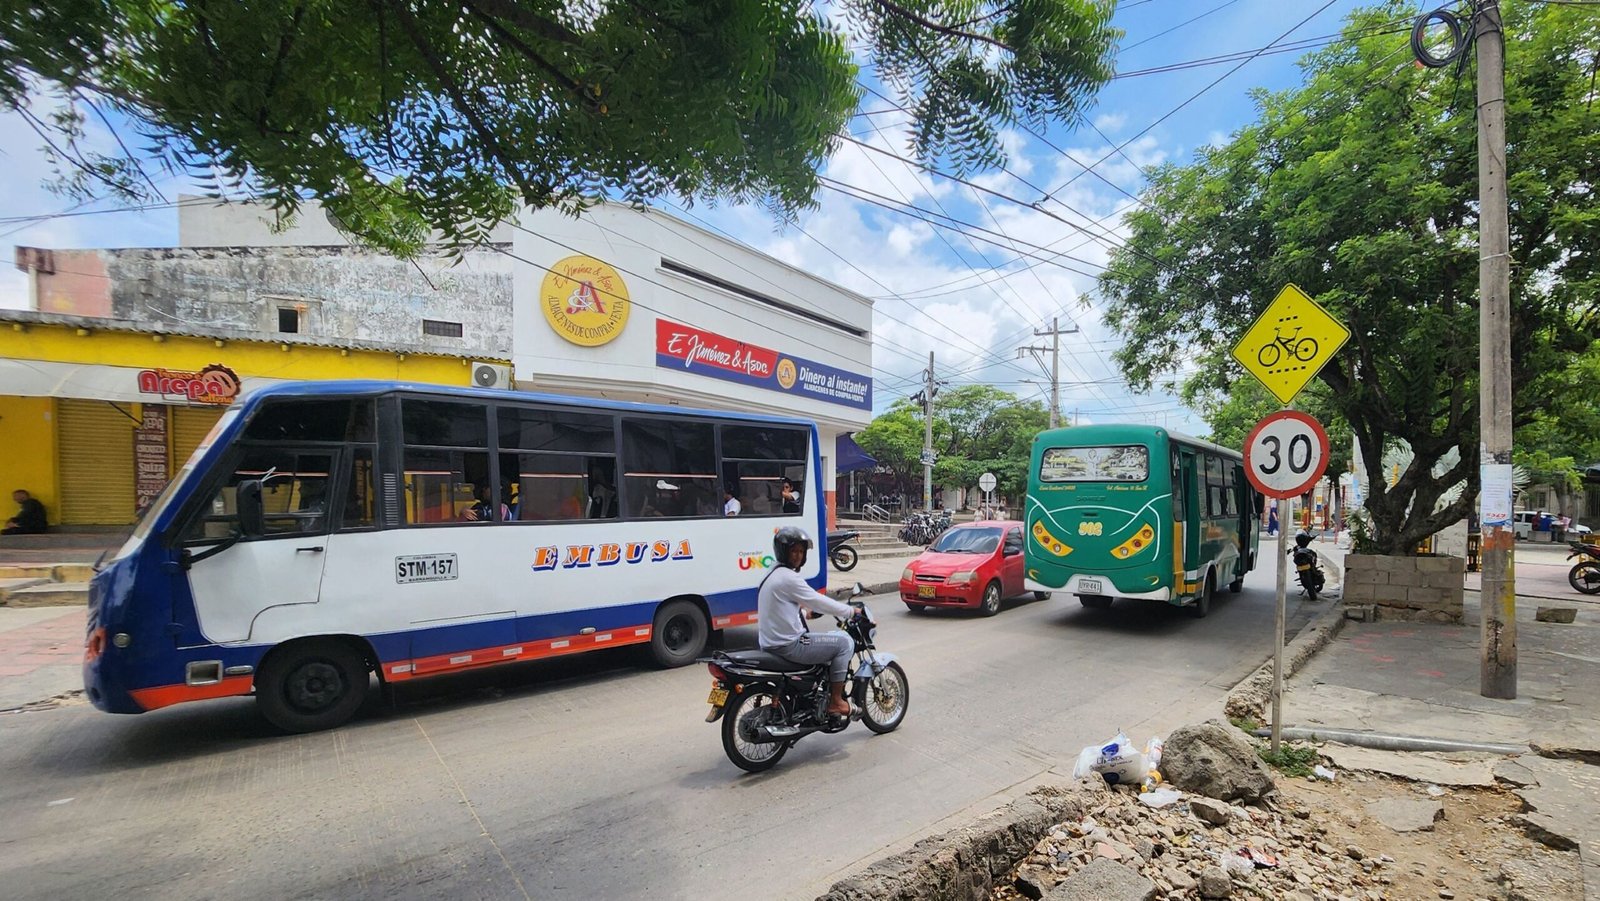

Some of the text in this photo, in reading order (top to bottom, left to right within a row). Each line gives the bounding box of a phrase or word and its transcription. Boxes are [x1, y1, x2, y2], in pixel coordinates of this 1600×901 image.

[685, 334, 731, 368] Jiménez
[731, 350, 742, 368] &
[743, 351, 769, 375] Asoc.
[138, 370, 225, 400] Arepa
[799, 366, 868, 396] Dinero al instante!
[803, 383, 829, 395] ALMACENES
[1259, 434, 1313, 475] 30
[532, 539, 694, 571] EMBUSA
